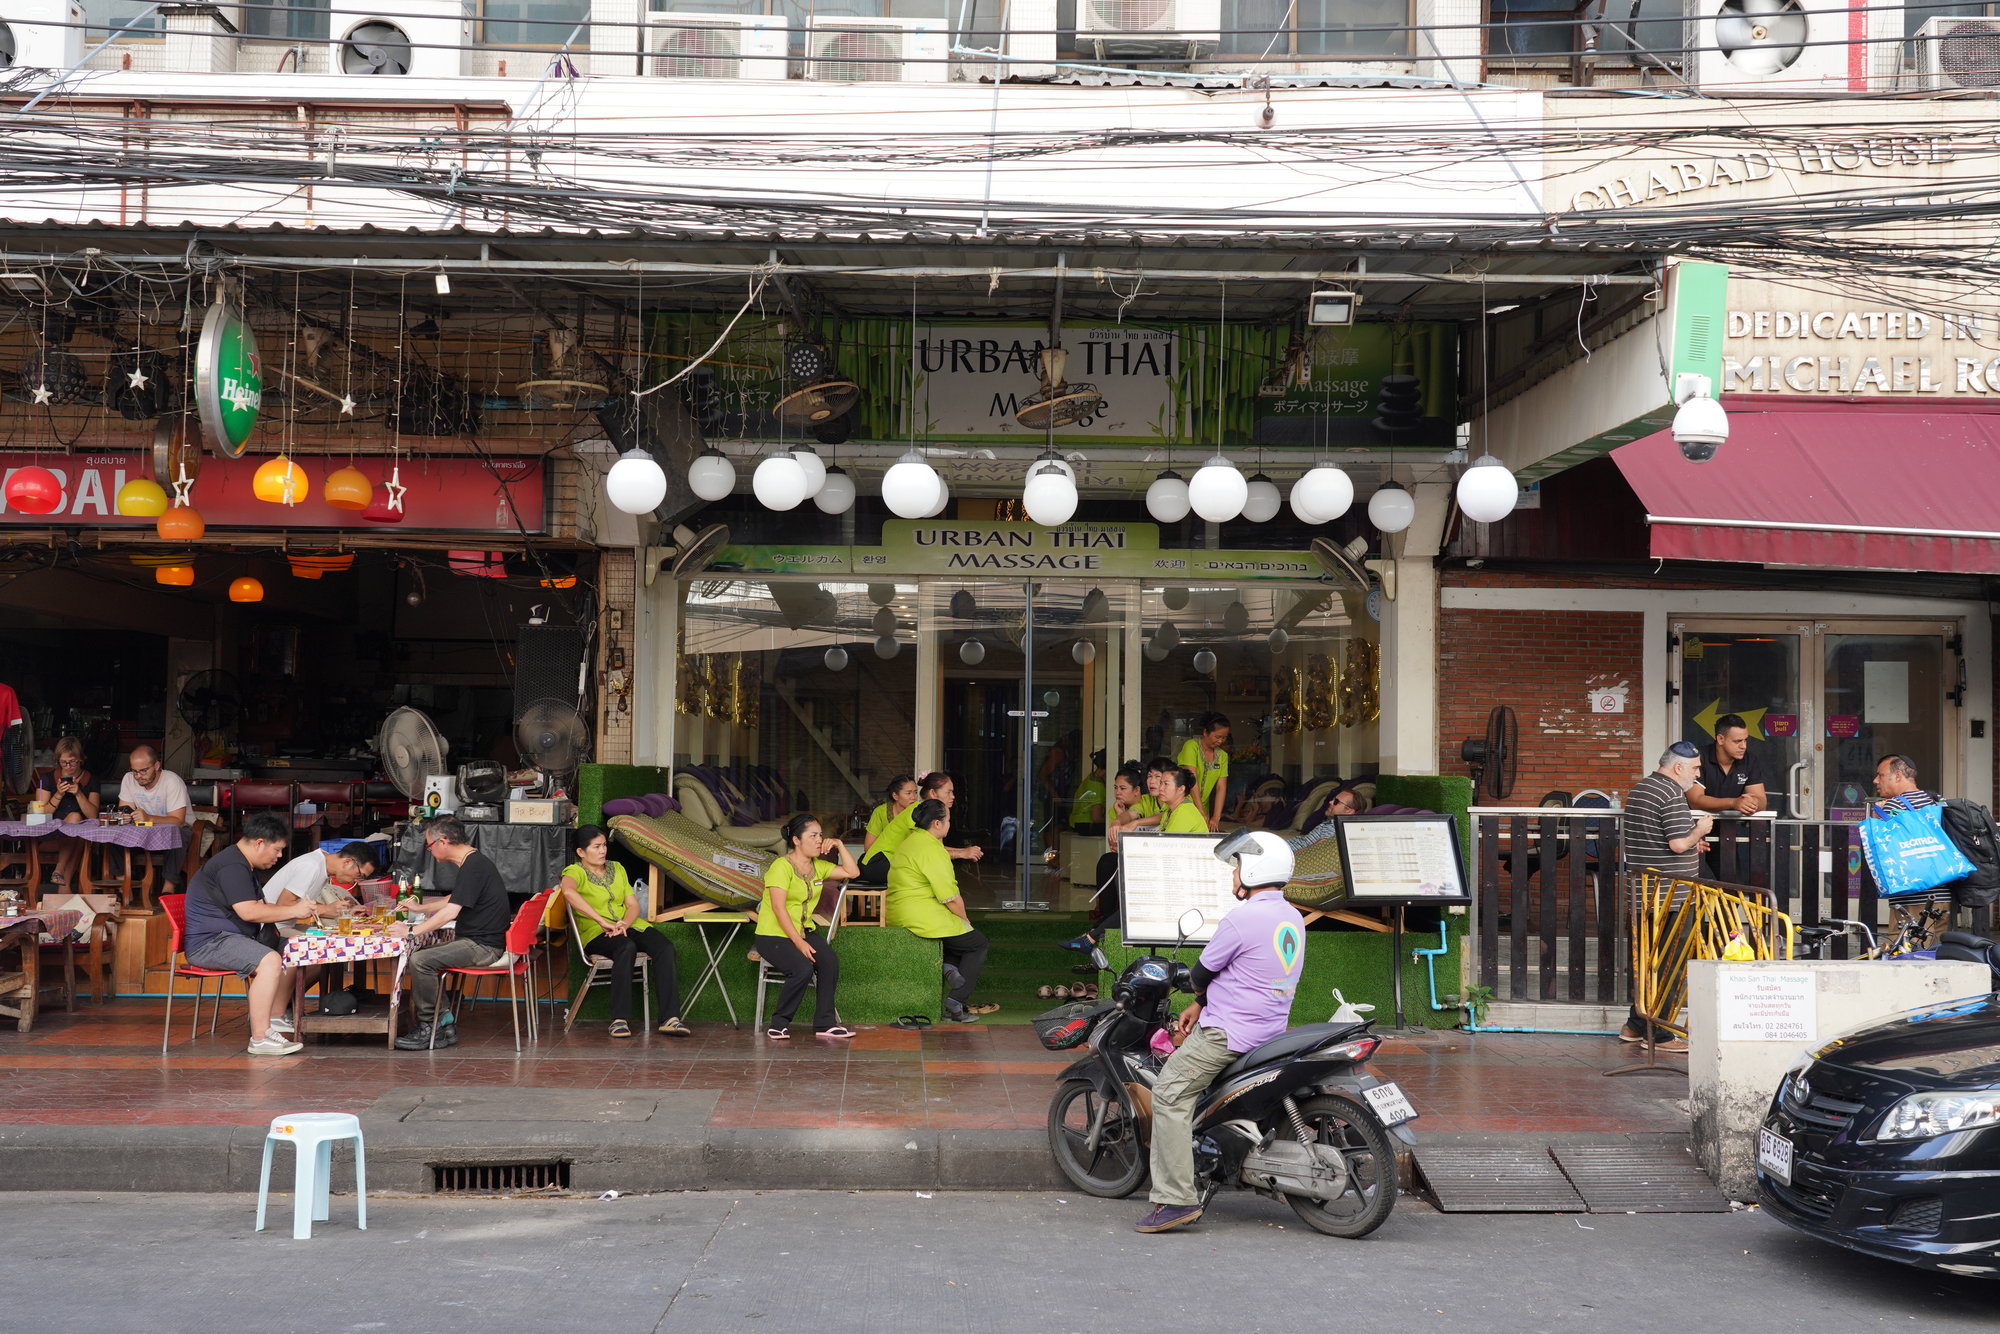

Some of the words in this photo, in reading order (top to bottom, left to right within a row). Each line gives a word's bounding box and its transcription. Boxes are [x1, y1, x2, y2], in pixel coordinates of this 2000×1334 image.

[1572, 152, 1776, 211] CHABAD
[1796, 137, 1955, 175] HOUSE
[1728, 311, 1931, 340] DEDICATED
[1942, 312, 1982, 340] IN
[1077, 341, 1172, 376] THAI
[1722, 355, 1942, 393] MICHAEL
[1294, 379, 1369, 399] Massage
[1273, 400, 1369, 413] ボディマッサージ
[915, 530, 1032, 547] URBAN
[1046, 532, 1124, 548] THAI
[773, 555, 843, 564] ウエルカム
[863, 555, 887, 564] 환영
[948, 553, 1100, 570] MASSAGE
[1154, 559, 1186, 569] 欢迎
[1208, 561, 1256, 570] הבאים
[1260, 562, 1308, 571] ברוכים
[1729, 975, 1746, 983] Khao
[1747, 975, 1760, 983] San
[1762, 975, 1777, 983] Thai
[1780, 975, 1809, 984] Massage
[1765, 1022, 1773, 1030] 02
[1775, 1022, 1803, 1030] 2824761
[1765, 1031, 1778, 1039] 084
[1389, 1108, 1407, 1121] 402
